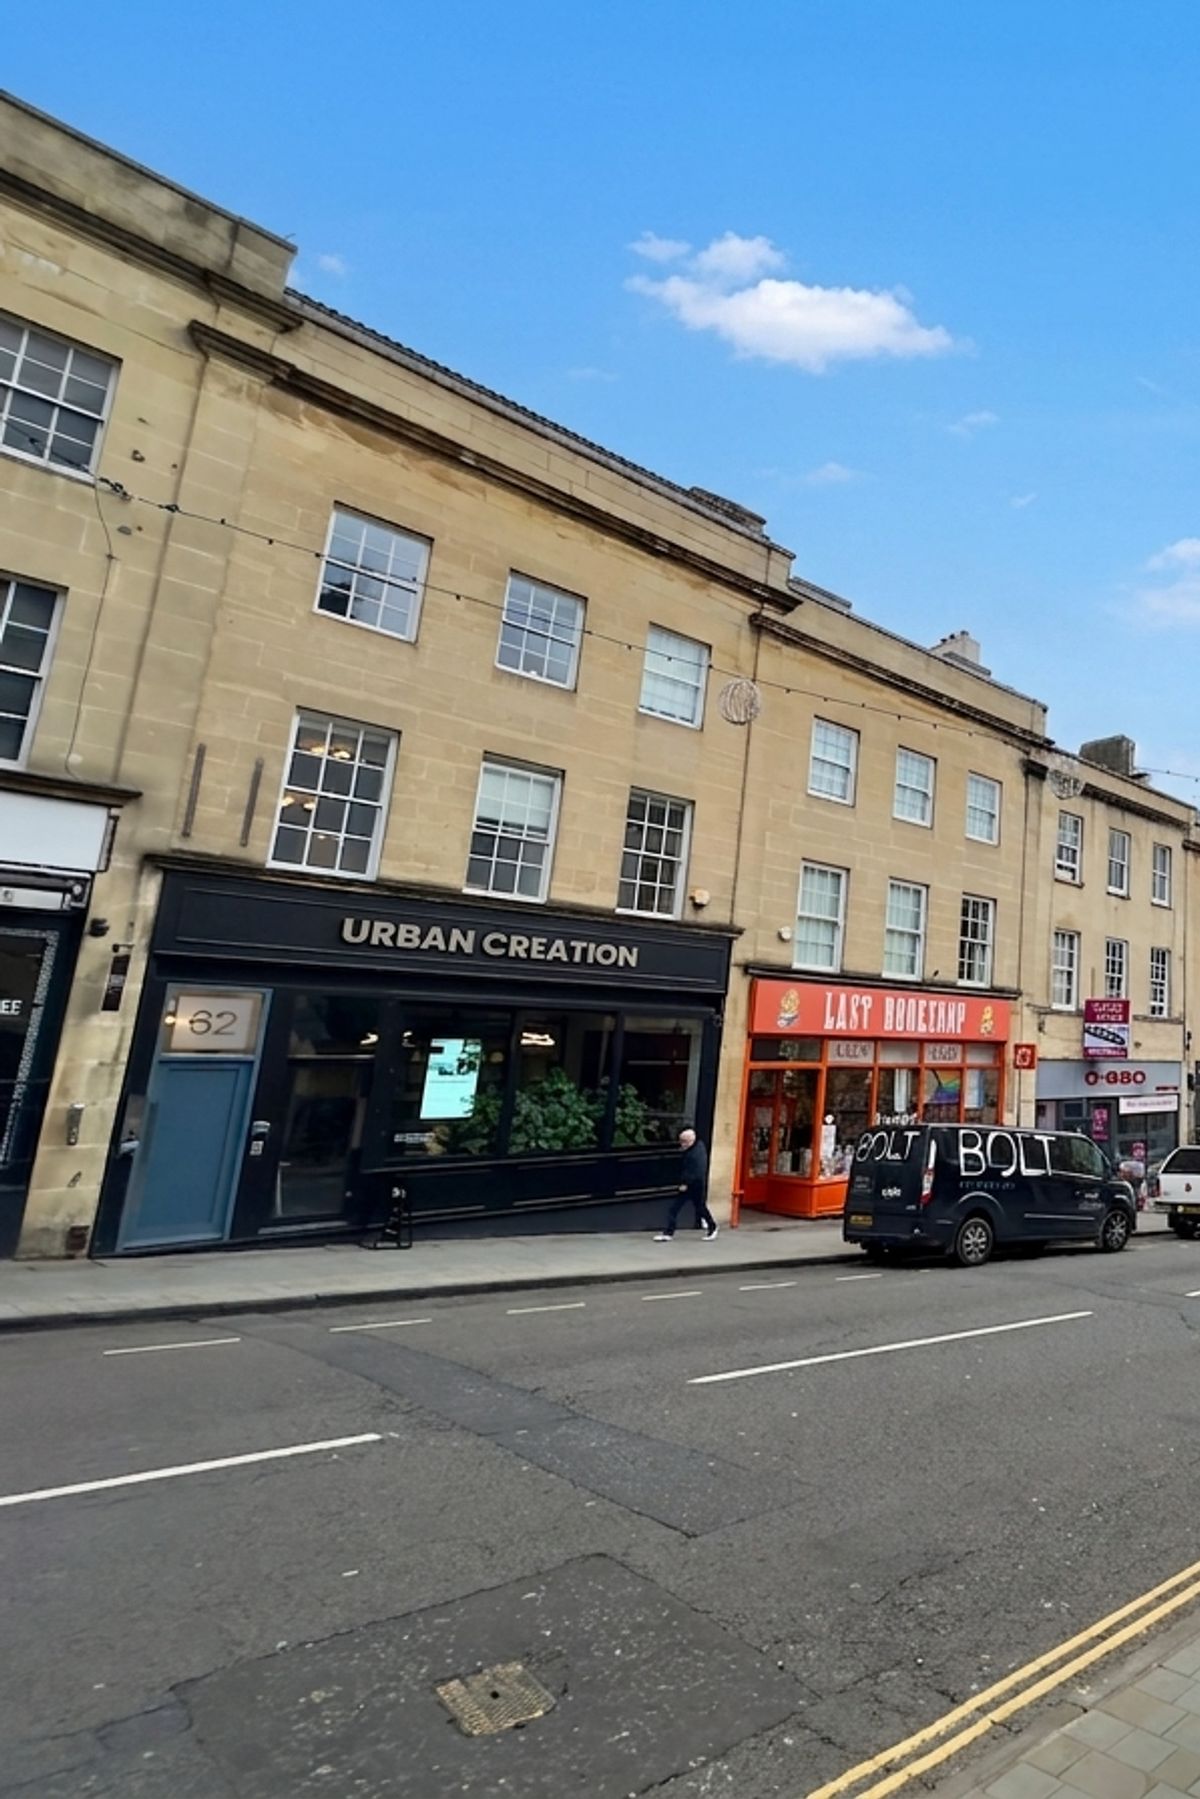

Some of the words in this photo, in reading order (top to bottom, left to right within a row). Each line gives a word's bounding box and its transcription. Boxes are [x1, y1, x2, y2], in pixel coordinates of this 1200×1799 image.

[342, 917, 476, 954] URBAN
[482, 931, 639, 968] CREATION
[0, 999, 23, 1016] EE
[189, 1009, 238, 1036] 62
[823, 991, 872, 1031] LAST
[856, 1130, 921, 1162] BOLT
[958, 1128, 1056, 1178] BOLT
